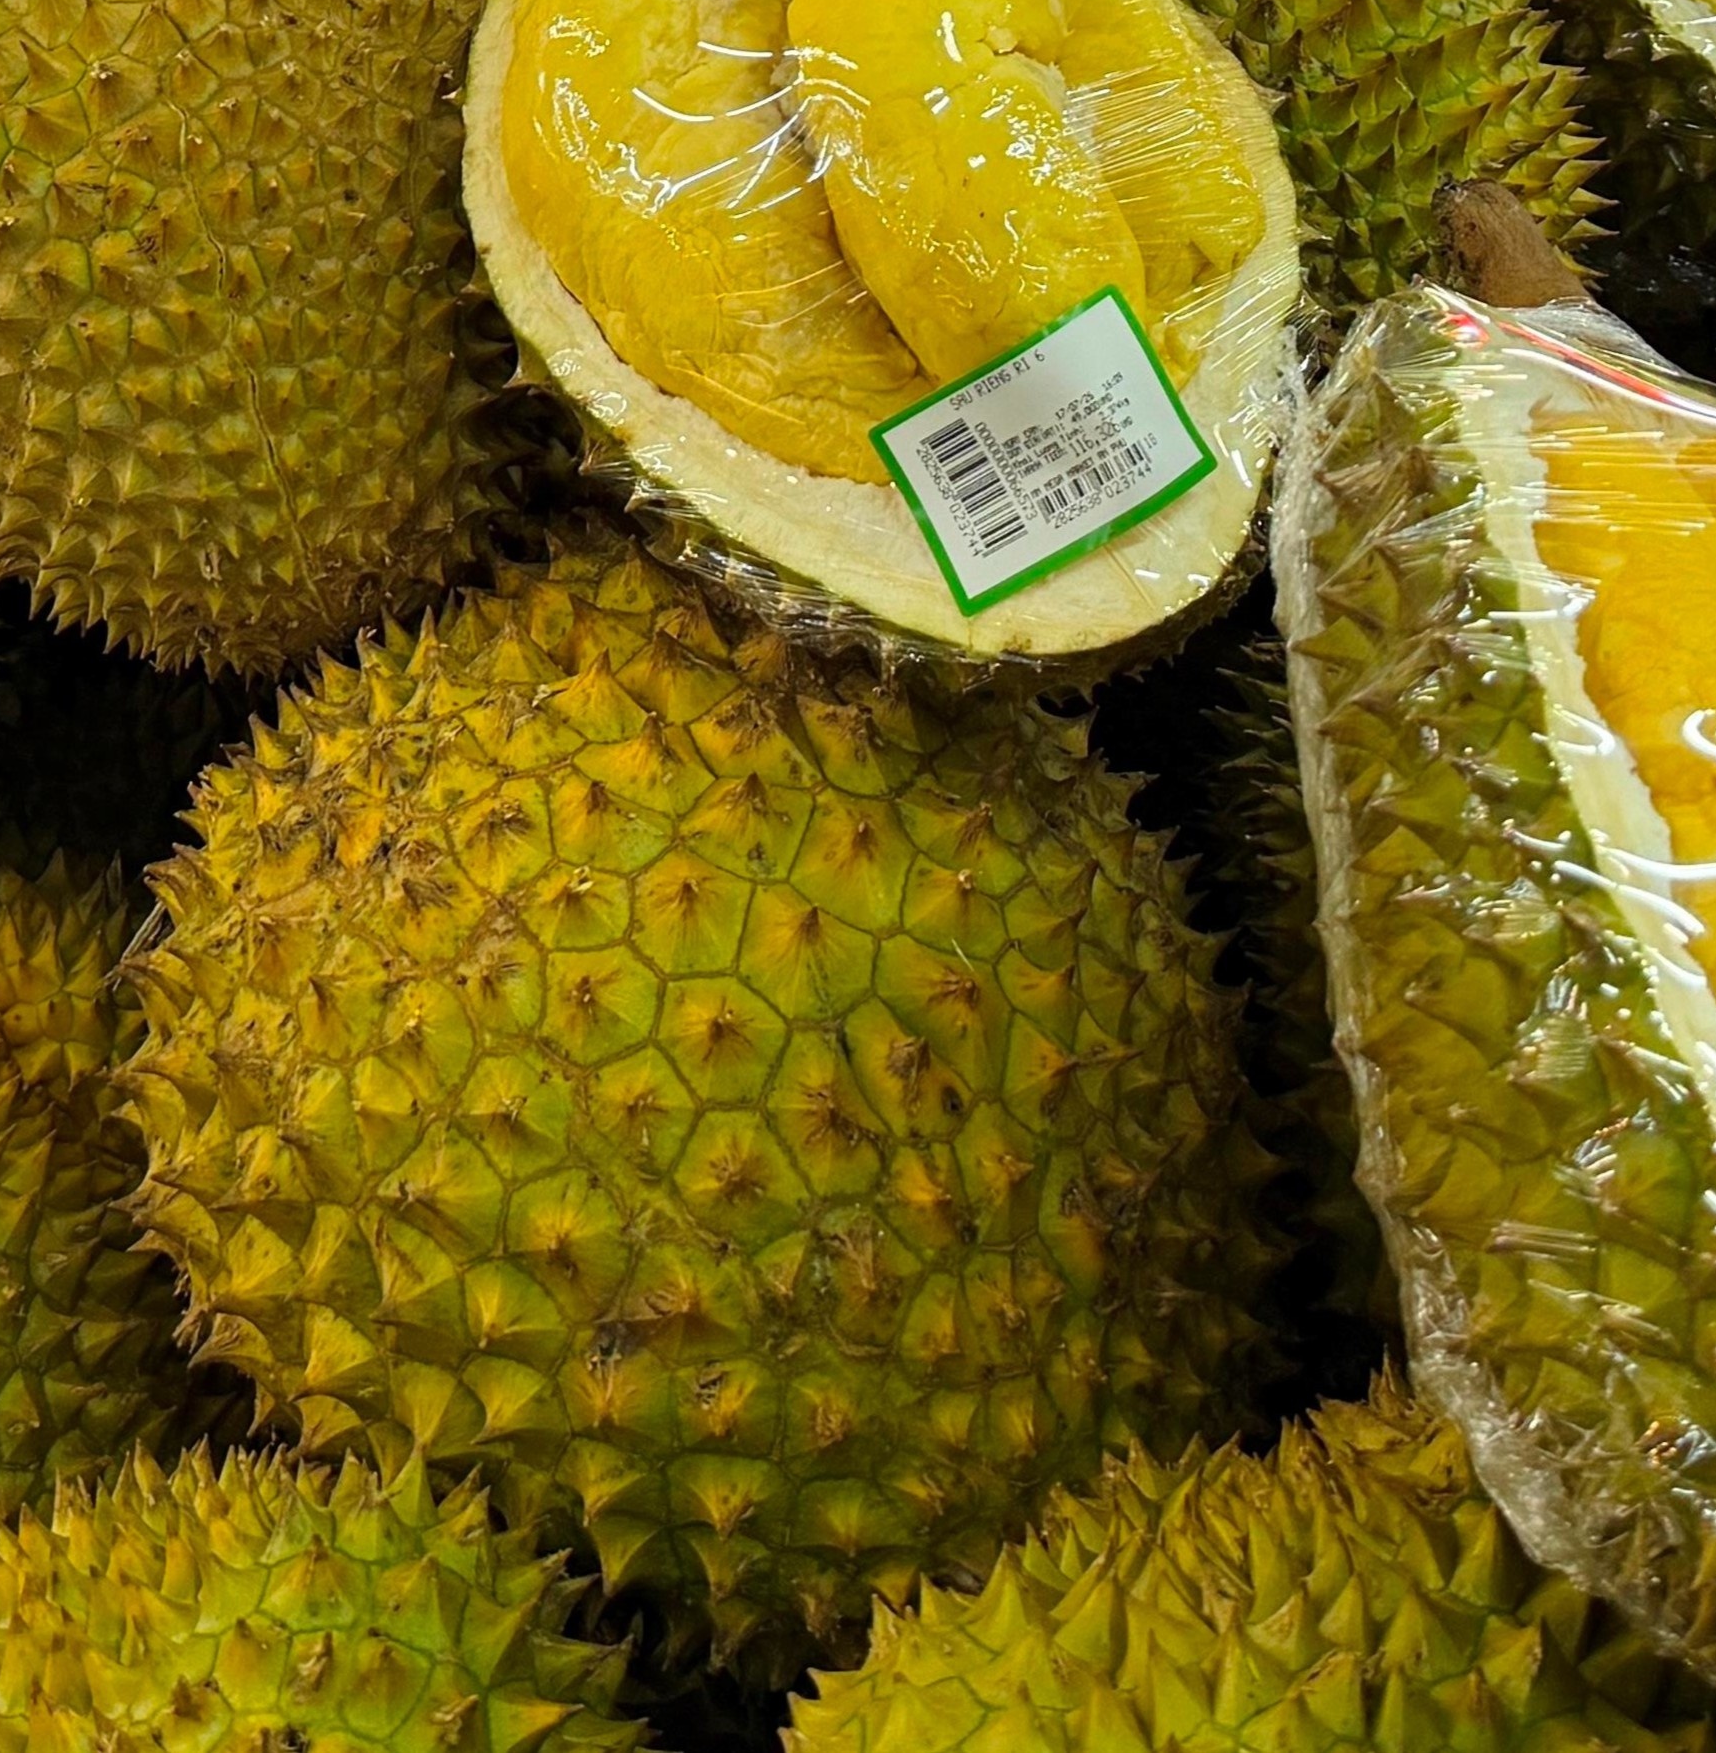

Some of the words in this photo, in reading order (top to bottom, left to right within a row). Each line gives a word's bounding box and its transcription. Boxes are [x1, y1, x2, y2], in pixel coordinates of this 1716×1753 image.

[949, 389, 973, 411] SAU
[975, 367, 1011, 397] RIENG
[1012, 356, 1030, 375] RI
[1033, 348, 1045, 362] 6
[1104, 463, 1152, 498] 023744
